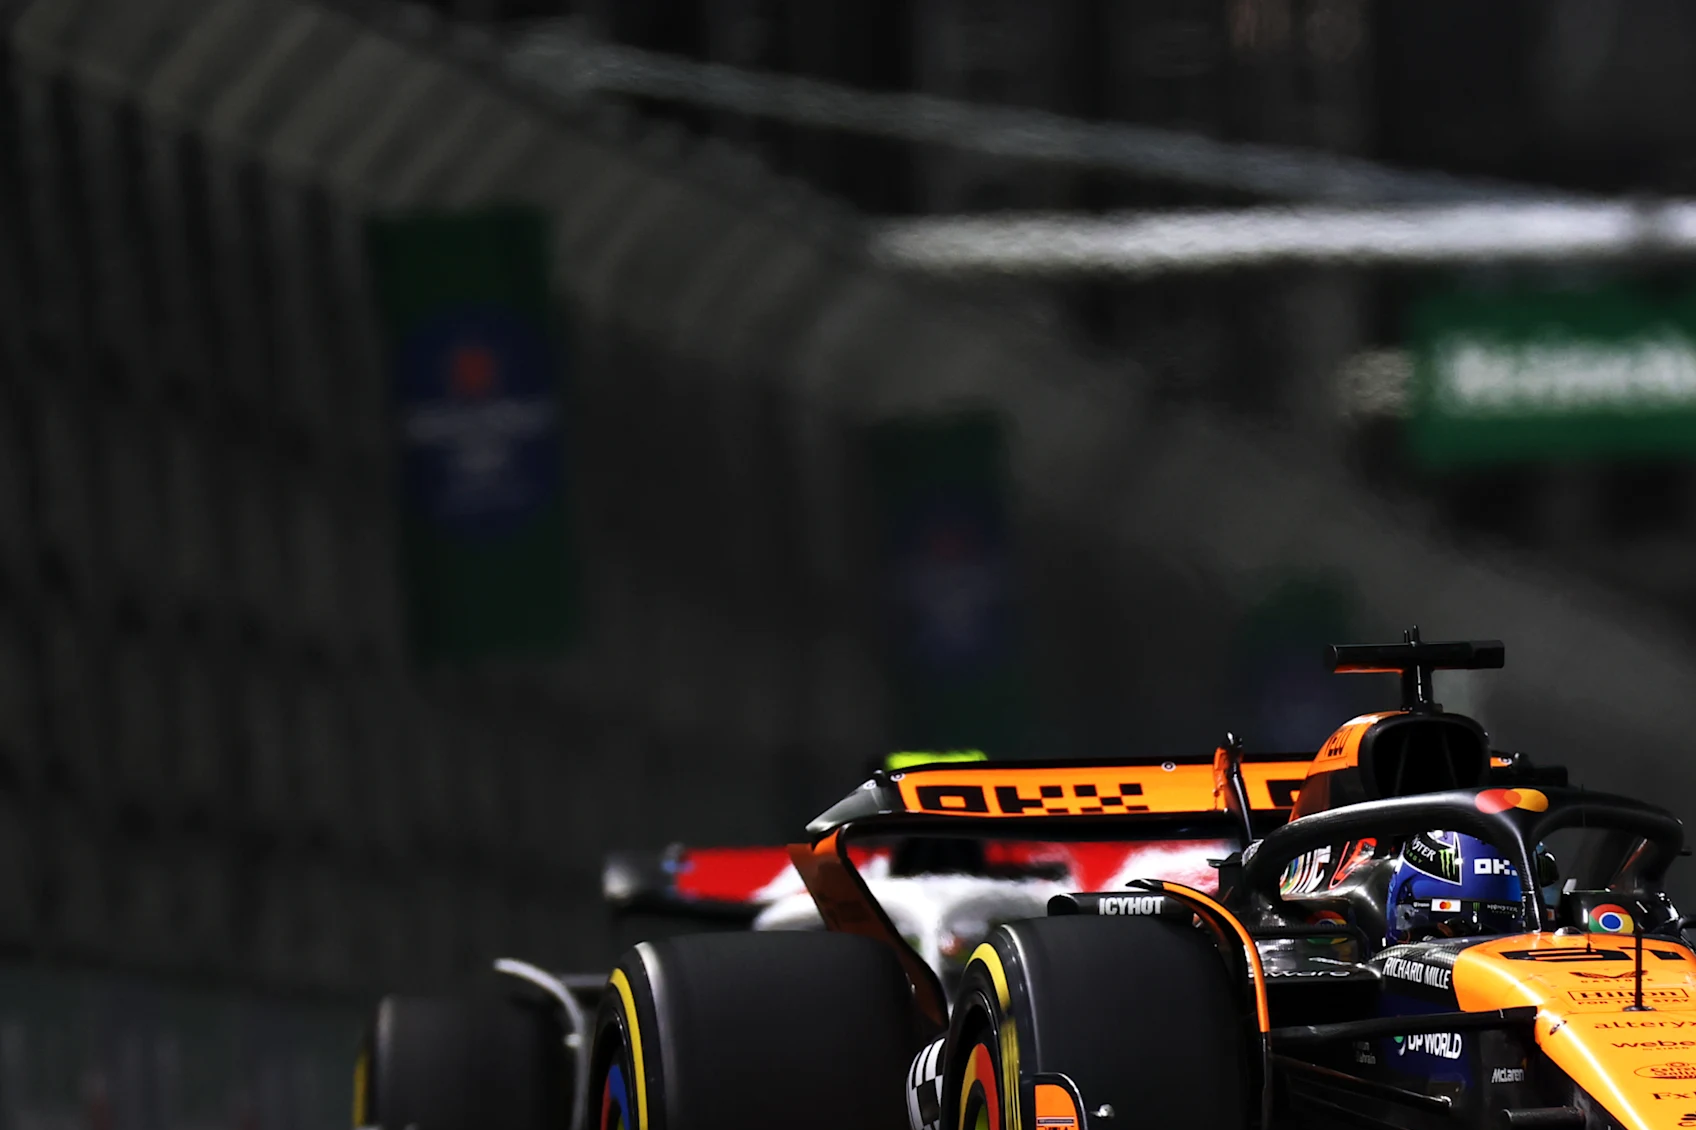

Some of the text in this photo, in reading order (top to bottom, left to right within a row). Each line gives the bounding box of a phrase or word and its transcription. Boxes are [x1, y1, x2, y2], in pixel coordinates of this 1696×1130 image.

[1098, 896, 1165, 916] ICYHOT
[1382, 956, 1452, 990] RICHARD MILLE
[1423, 1033, 1463, 1060] WORLD
[1491, 1068, 1525, 1083] McLaren
